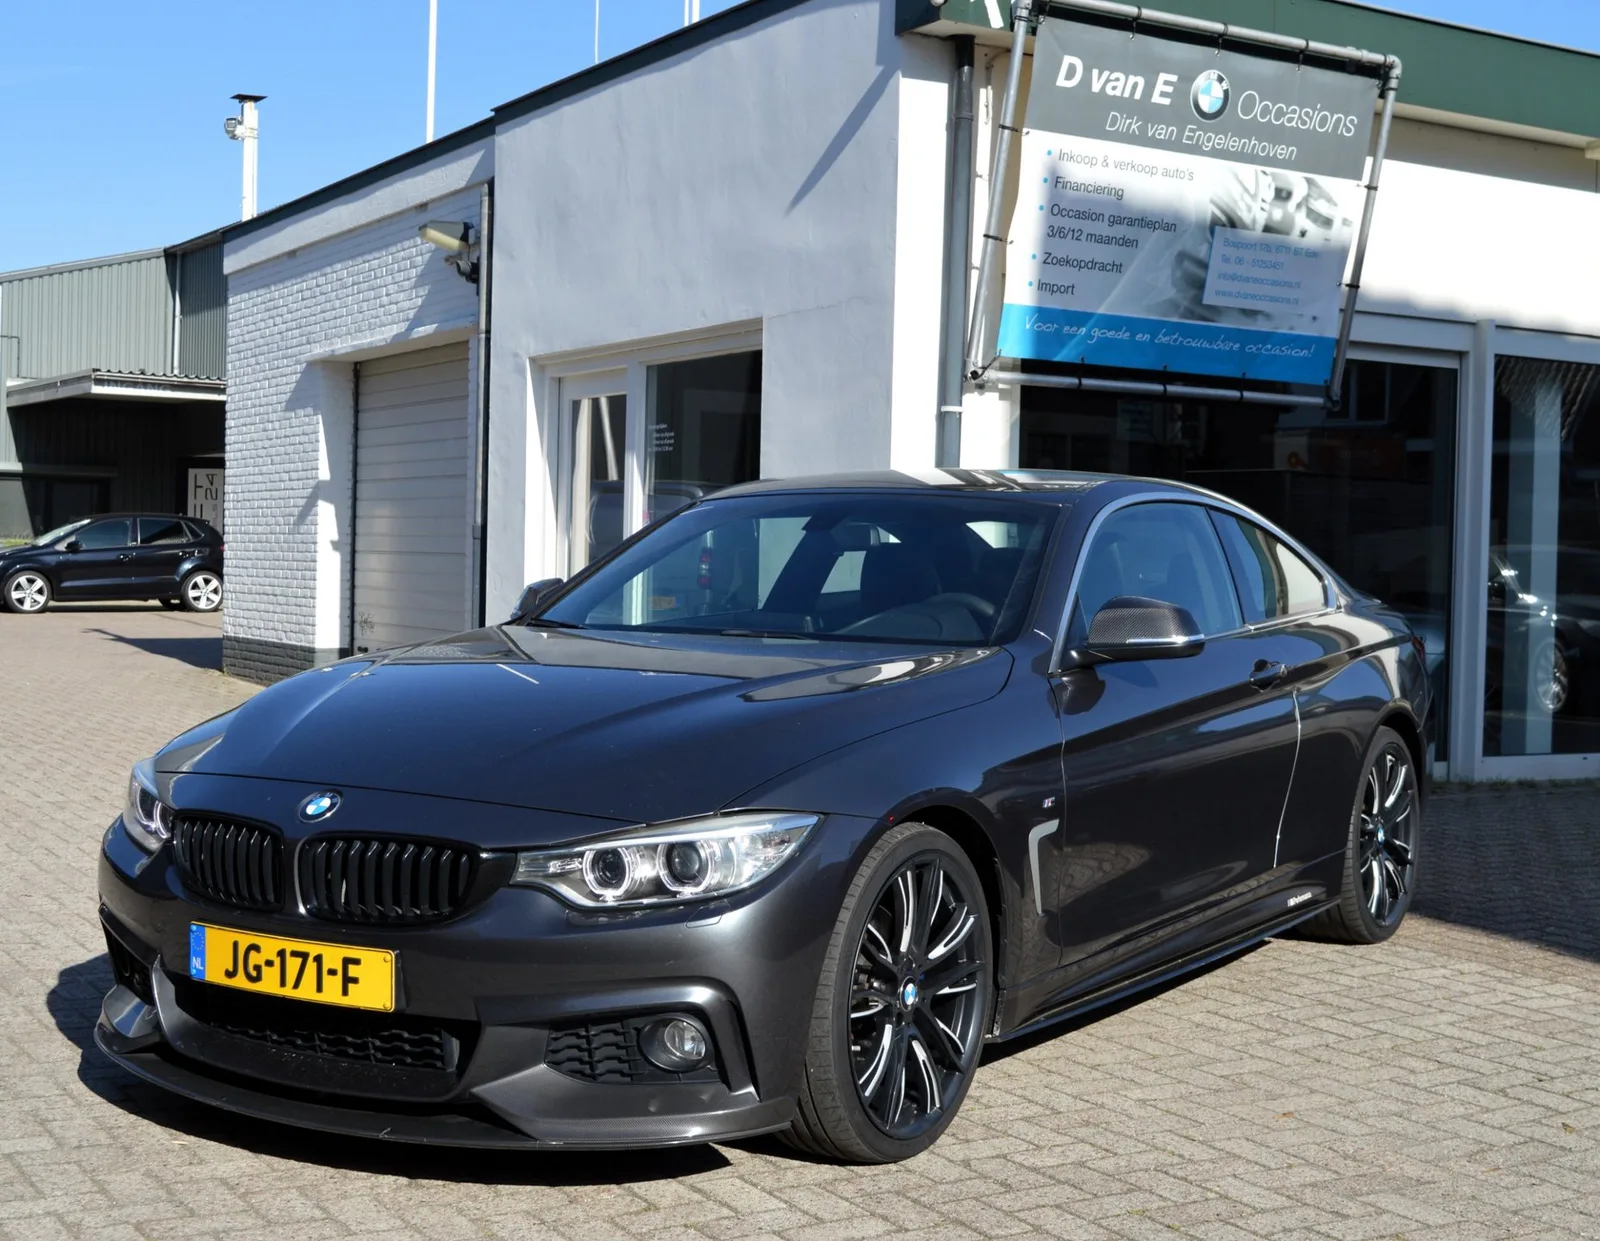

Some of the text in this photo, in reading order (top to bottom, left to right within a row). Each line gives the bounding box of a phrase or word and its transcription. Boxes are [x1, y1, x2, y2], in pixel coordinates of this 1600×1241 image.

[1055, 54, 1179, 105] D van E
[1237, 90, 1358, 137] Occasions
[1105, 111, 1297, 160] Dirk van Engelenhoven
[1058, 148, 1194, 181] Inkoop & verkoop auto's
[1054, 176, 1124, 201] Financiering
[1050, 203, 1177, 233] Occasion garantieplan
[1046, 225, 1139, 249] 3/6/12 maanden
[1043, 252, 1123, 274] Zoekopdracht
[1037, 279, 1075, 296] Import
[1024, 313, 1315, 357] Voor een goede en betrouwbare occasion!
[192, 955, 203, 970] NL
[224, 940, 361, 997] JG-171-F
